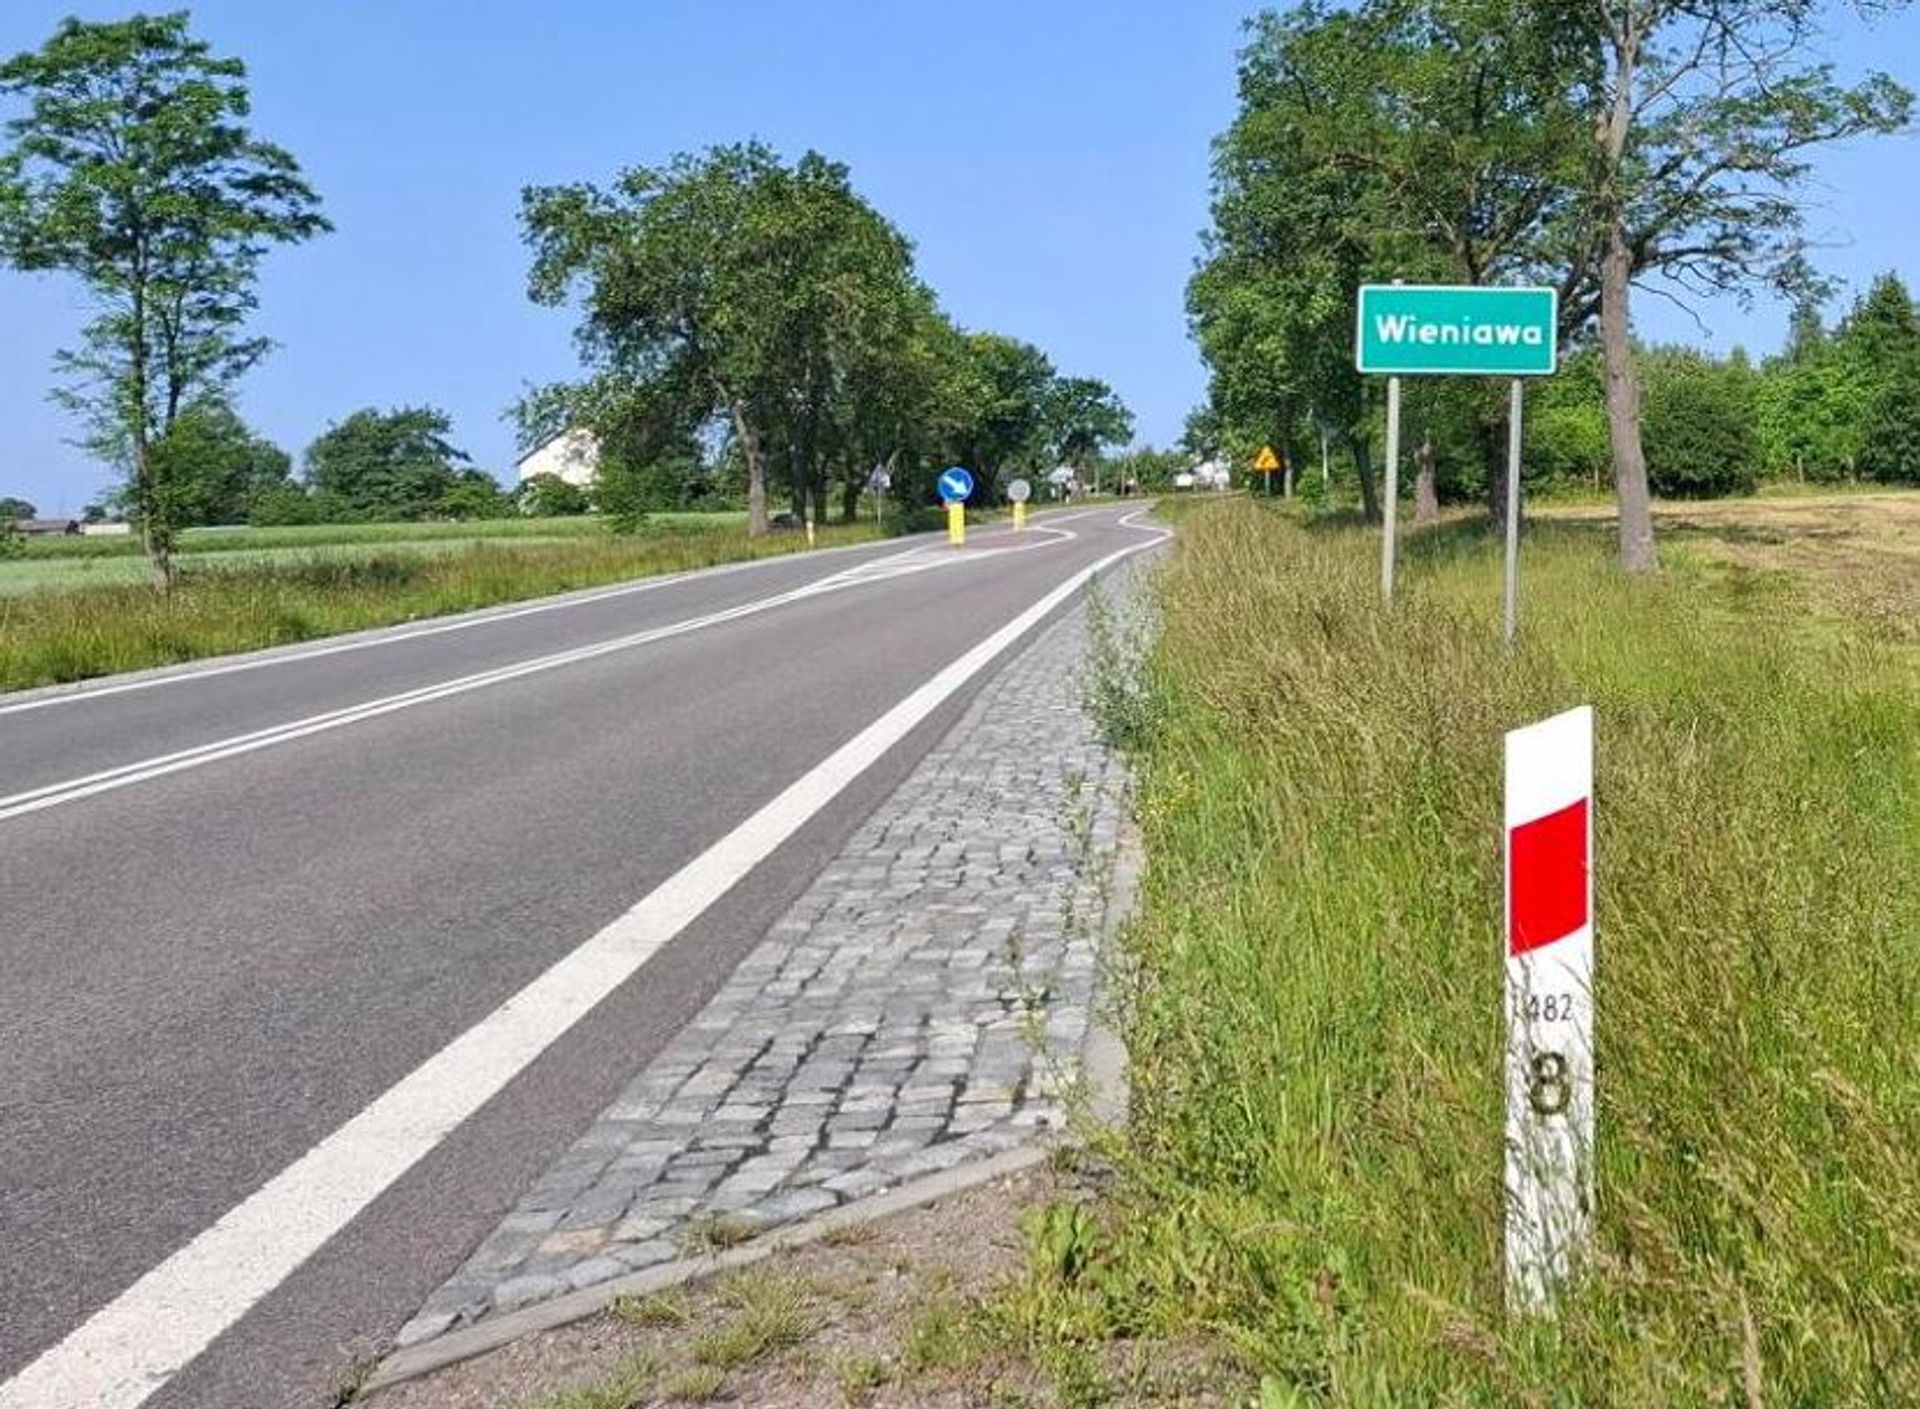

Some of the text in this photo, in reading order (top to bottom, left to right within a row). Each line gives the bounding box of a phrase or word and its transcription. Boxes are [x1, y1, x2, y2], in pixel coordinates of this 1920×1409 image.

[1375, 314, 1543, 345] Wieniawa
[1527, 993, 1572, 1021] 482
[1530, 1052, 1571, 1115] 8
